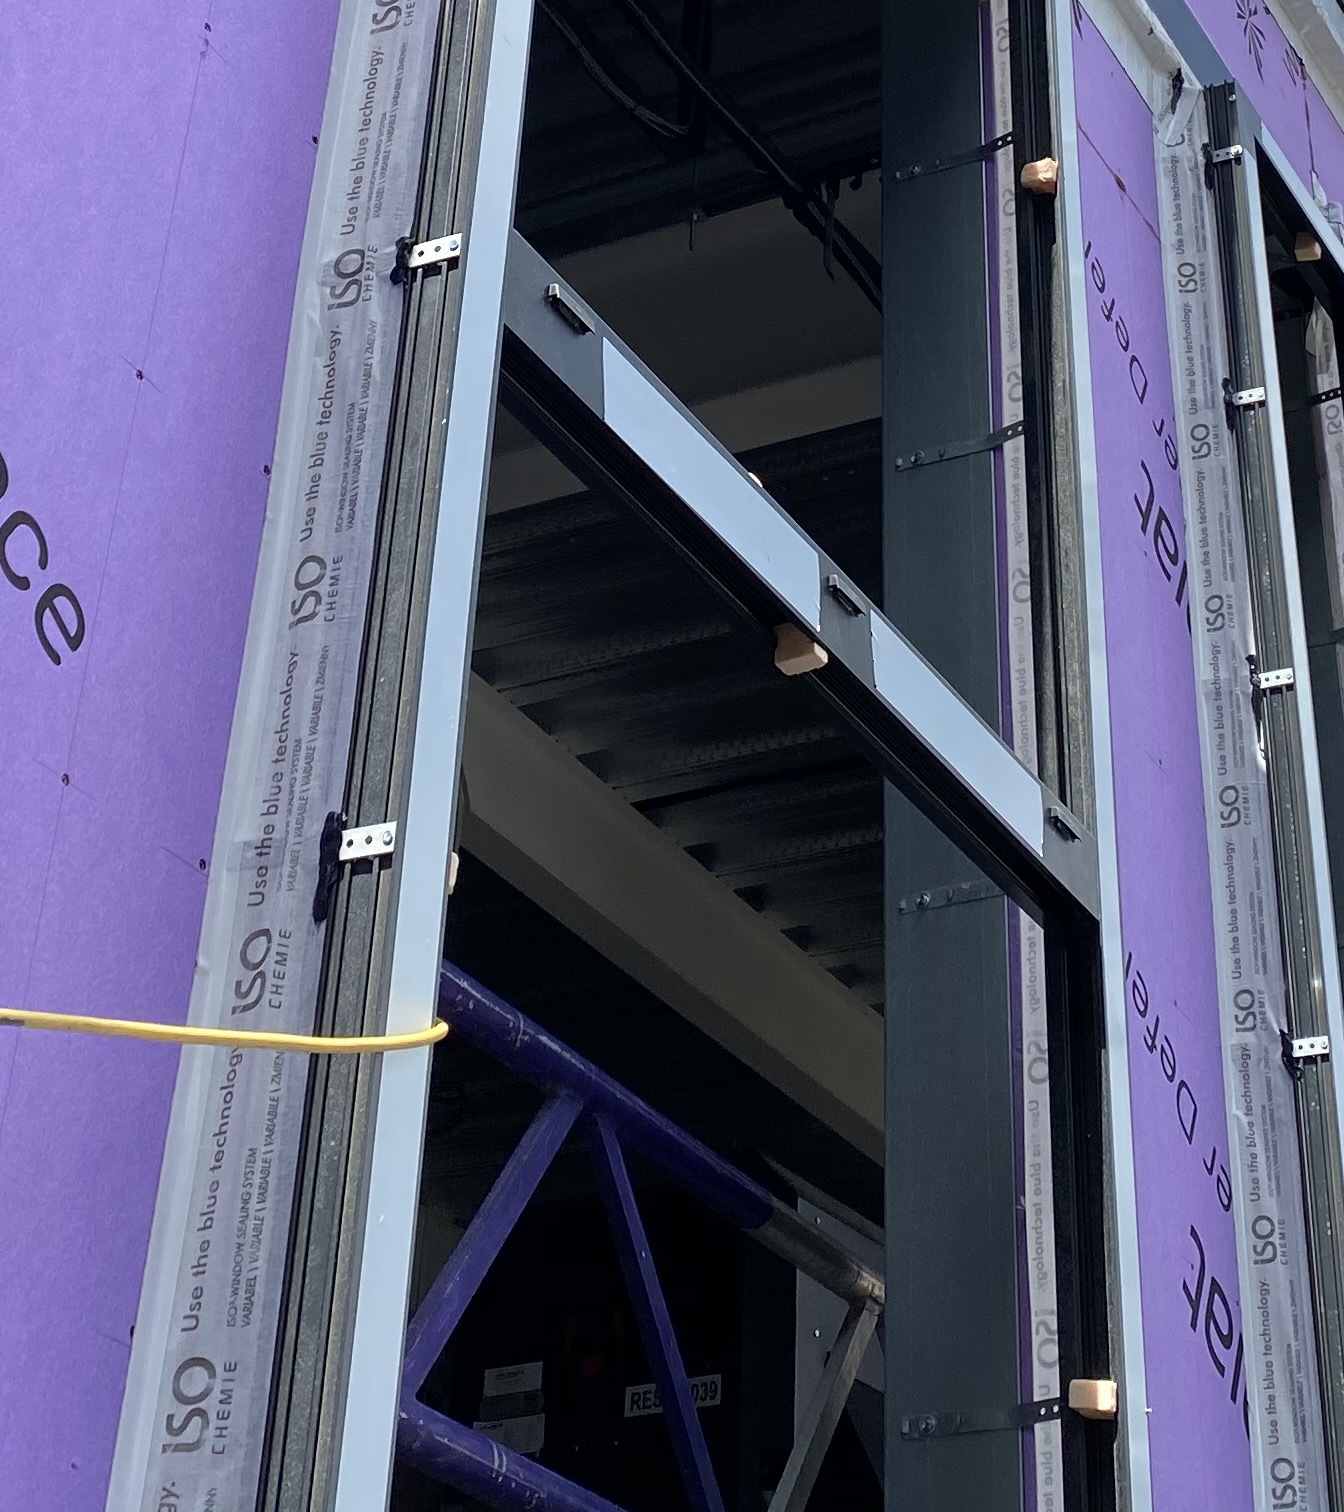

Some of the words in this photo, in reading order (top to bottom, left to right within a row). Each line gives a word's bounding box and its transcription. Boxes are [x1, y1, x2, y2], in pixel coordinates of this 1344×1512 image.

[351, 135, 369, 168] blue
[347, 171, 364, 199] the
[341, 204, 359, 235] Use
[360, 245, 378, 302] CHEMIE
[309, 430, 327, 467] blue
[304, 471, 321, 501] the
[298, 506, 316, 547] Use
[324, 553, 343, 622] CHEMIE
[1212, 705, 1224, 729] blue
[1214, 732, 1226, 750] the
[1216, 754, 1228, 775] Use
[260, 770, 282, 817] blue
[254, 823, 275, 857] the
[247, 863, 269, 908] Use
[1227, 908, 1239, 933] blue
[1229, 935, 1241, 954] the
[268, 929, 292, 1009] CHEMIE
[1231, 958, 1243, 979] Use
[1243, 1121, 1257, 1148] blue
[1246, 1153, 1259, 1173] the
[196, 1178, 221, 1233] blue
[1248, 1178, 1261, 1202] Use
[189, 1237, 211, 1277] the
[1275, 1218, 1290, 1265] CHEMIE
[180, 1284, 204, 1333] Use
[1261, 1361, 1276, 1391] blue
[210, 1359, 238, 1455] CHEMIE
[1264, 1393, 1278, 1415] the
[1266, 1419, 1281, 1445] Use
